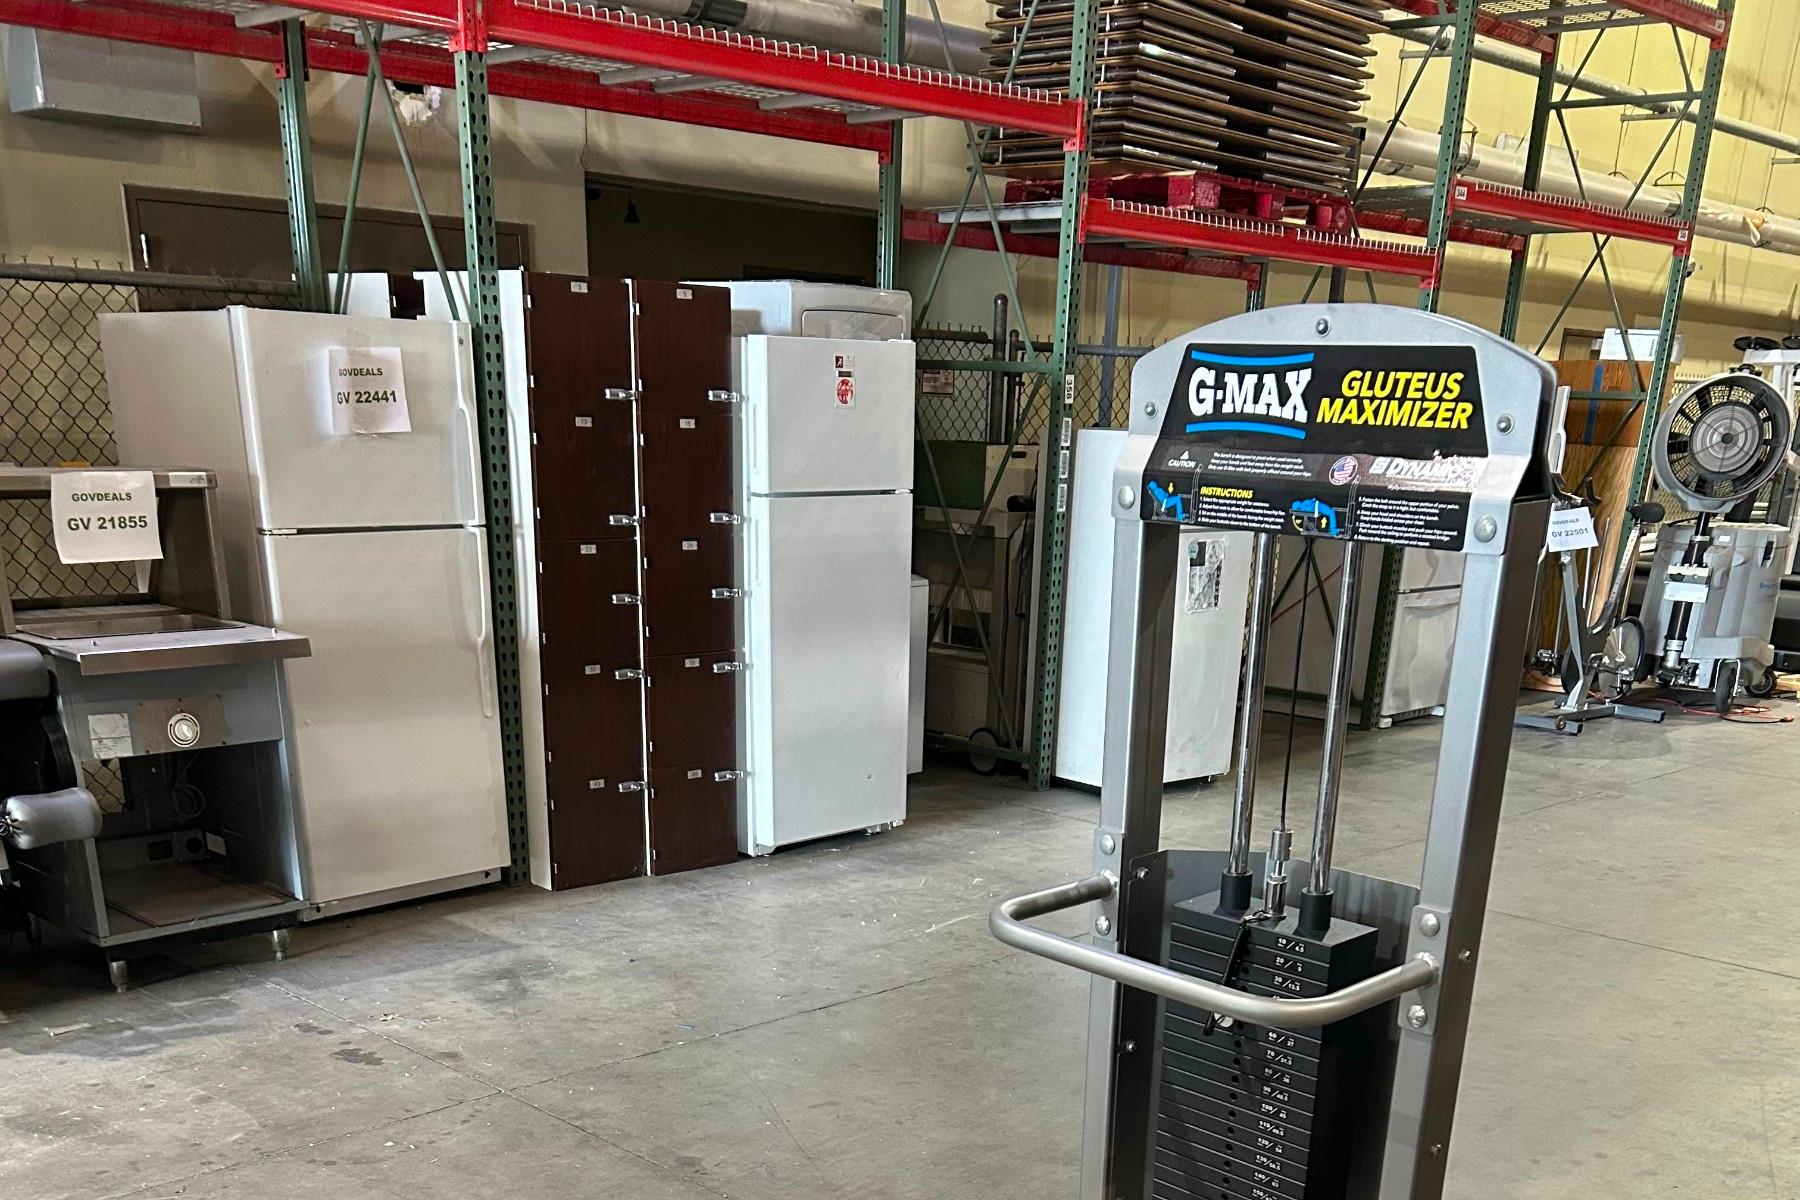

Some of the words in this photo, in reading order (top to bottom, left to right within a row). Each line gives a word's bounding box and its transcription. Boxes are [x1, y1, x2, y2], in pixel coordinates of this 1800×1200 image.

[338, 368, 383, 376] GOVDEALS
[1341, 370, 1464, 400] GLUTEUS
[337, 392, 350, 404] GV
[354, 390, 397, 404] 22441
[1316, 398, 1473, 429] MAXIMIZER
[1168, 459, 1196, 468] CAUTION
[72, 492, 132, 502] GOVDEALS
[1200, 486, 1254, 498] INSTRUCTIONS
[68, 518, 91, 531] GV
[97, 516, 148, 530] 21855
[1564, 528, 1588, 536] 22501
